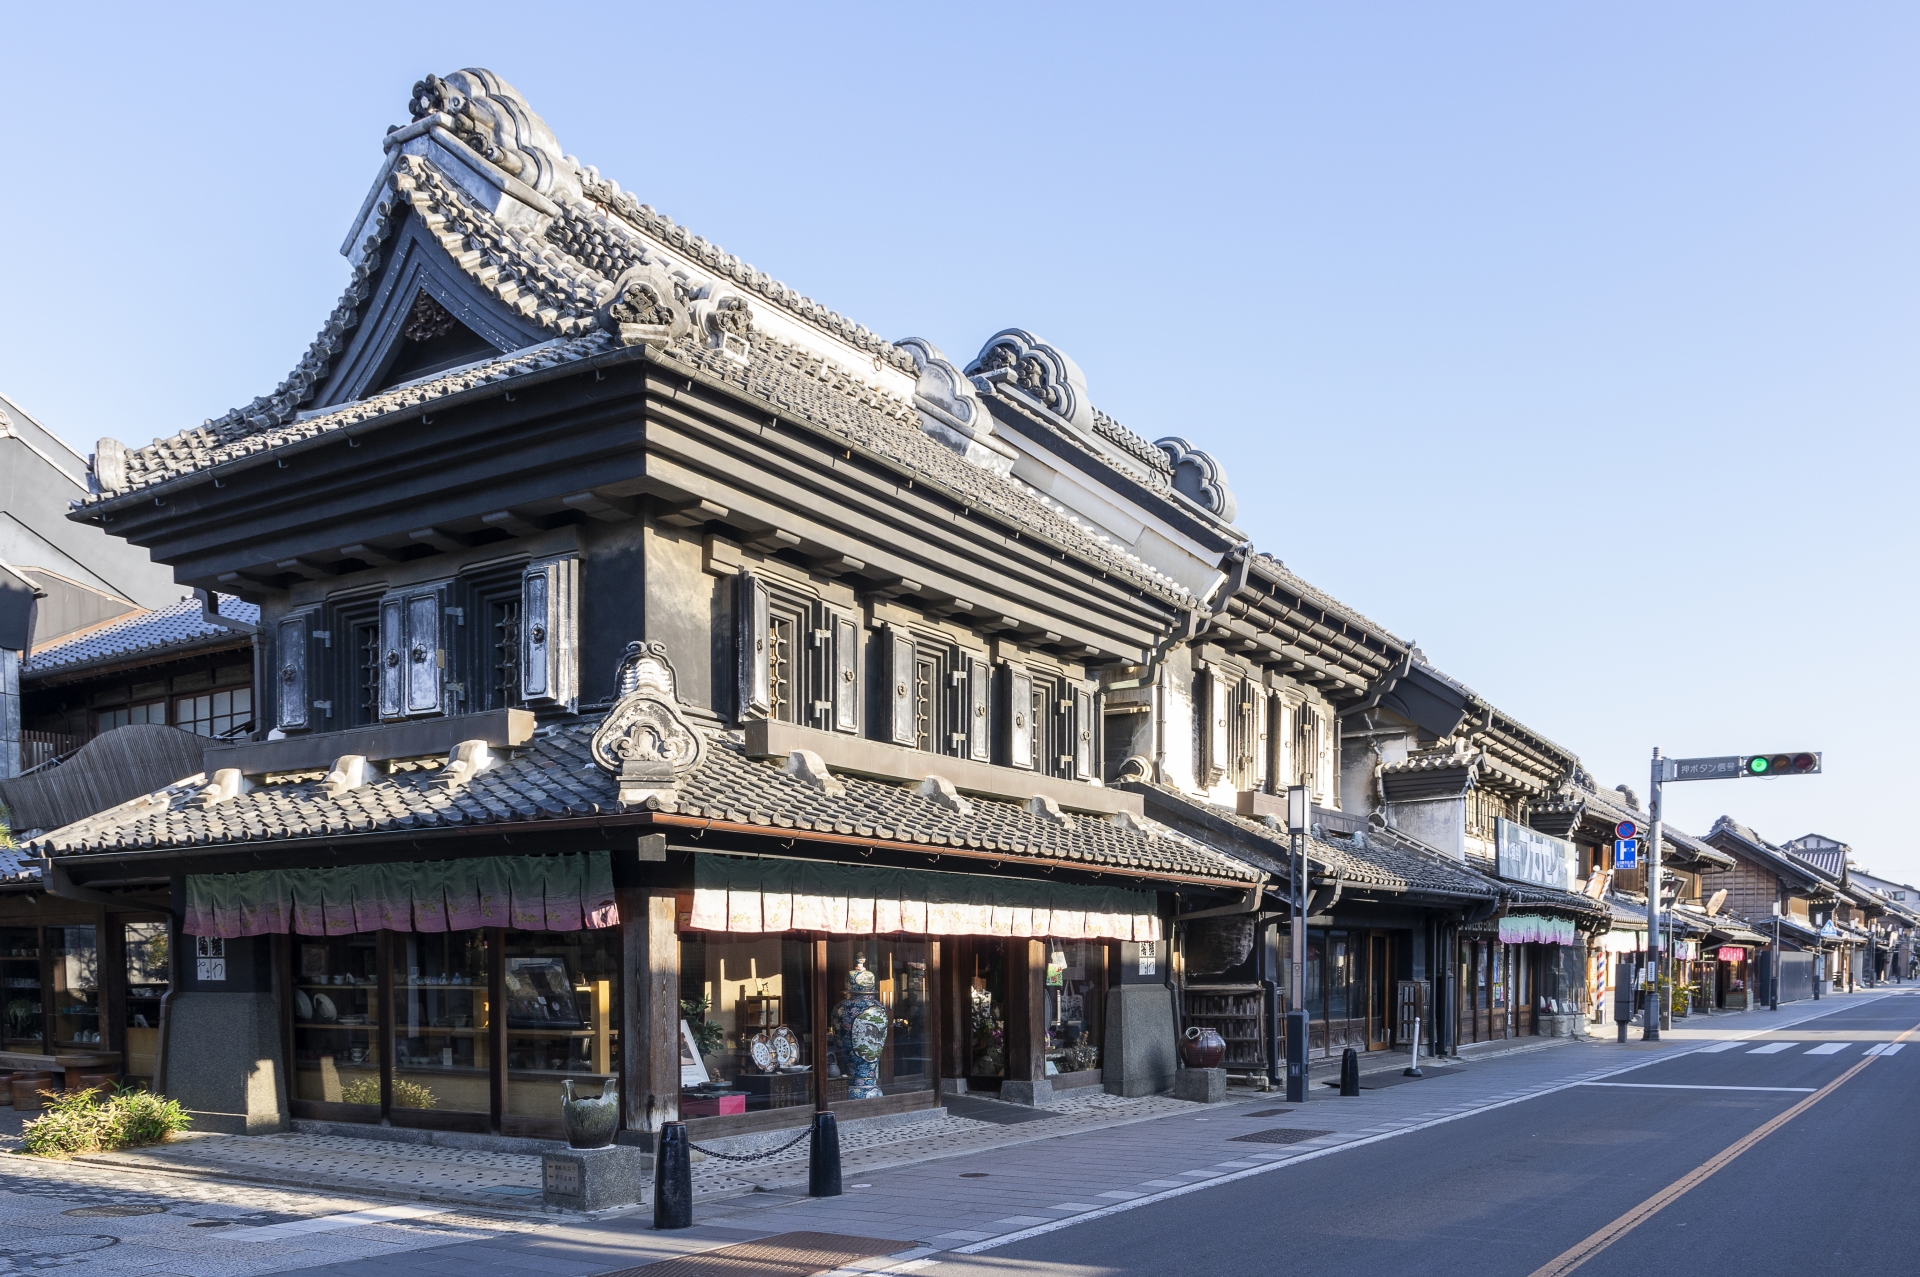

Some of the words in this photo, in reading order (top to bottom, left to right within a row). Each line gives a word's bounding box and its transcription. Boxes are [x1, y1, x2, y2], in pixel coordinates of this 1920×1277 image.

[1681, 762, 1735, 774] 押ボタン信号
